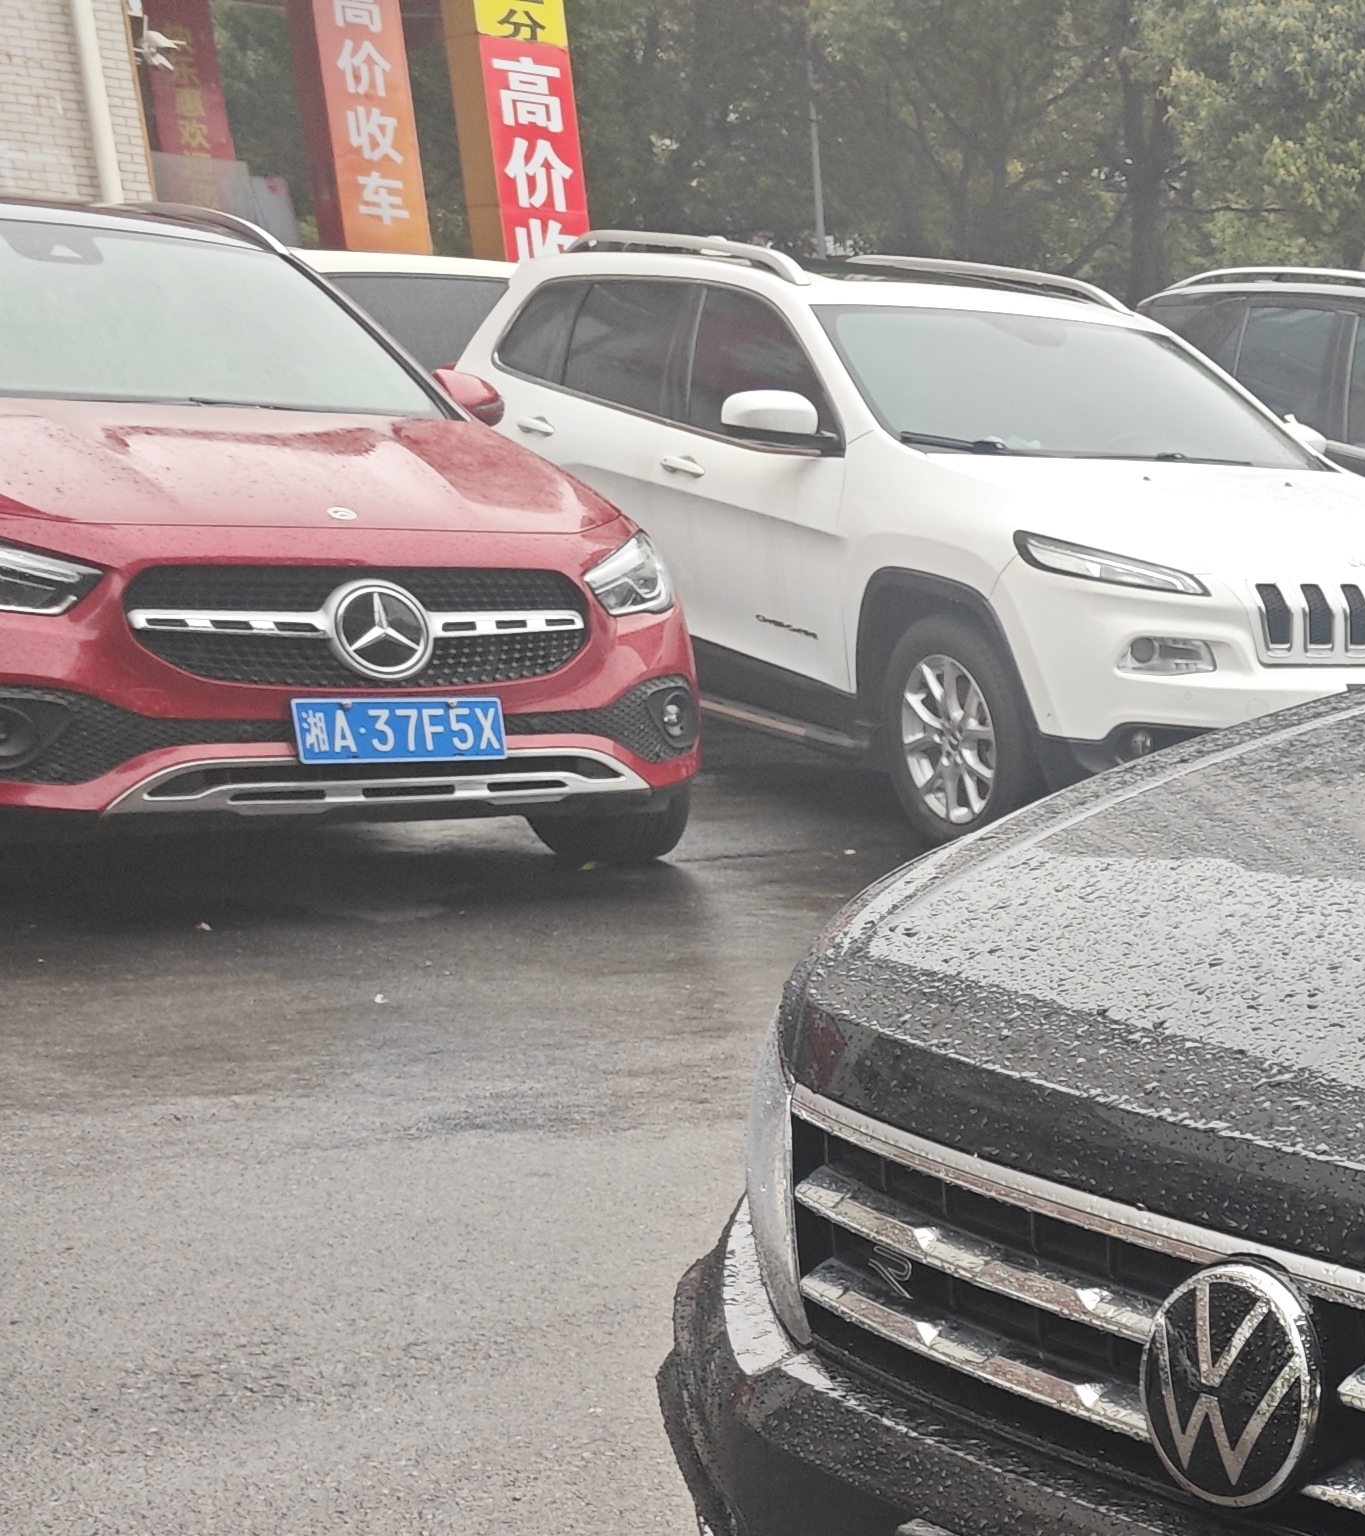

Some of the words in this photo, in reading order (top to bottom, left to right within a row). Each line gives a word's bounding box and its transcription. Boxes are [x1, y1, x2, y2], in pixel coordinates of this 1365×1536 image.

[497, 0, 547, 41] 分
[333, 0, 410, 227] 高价收车
[491, 56, 579, 263] 高价收
[301, 707, 501, 753] 湘A·37F5X
